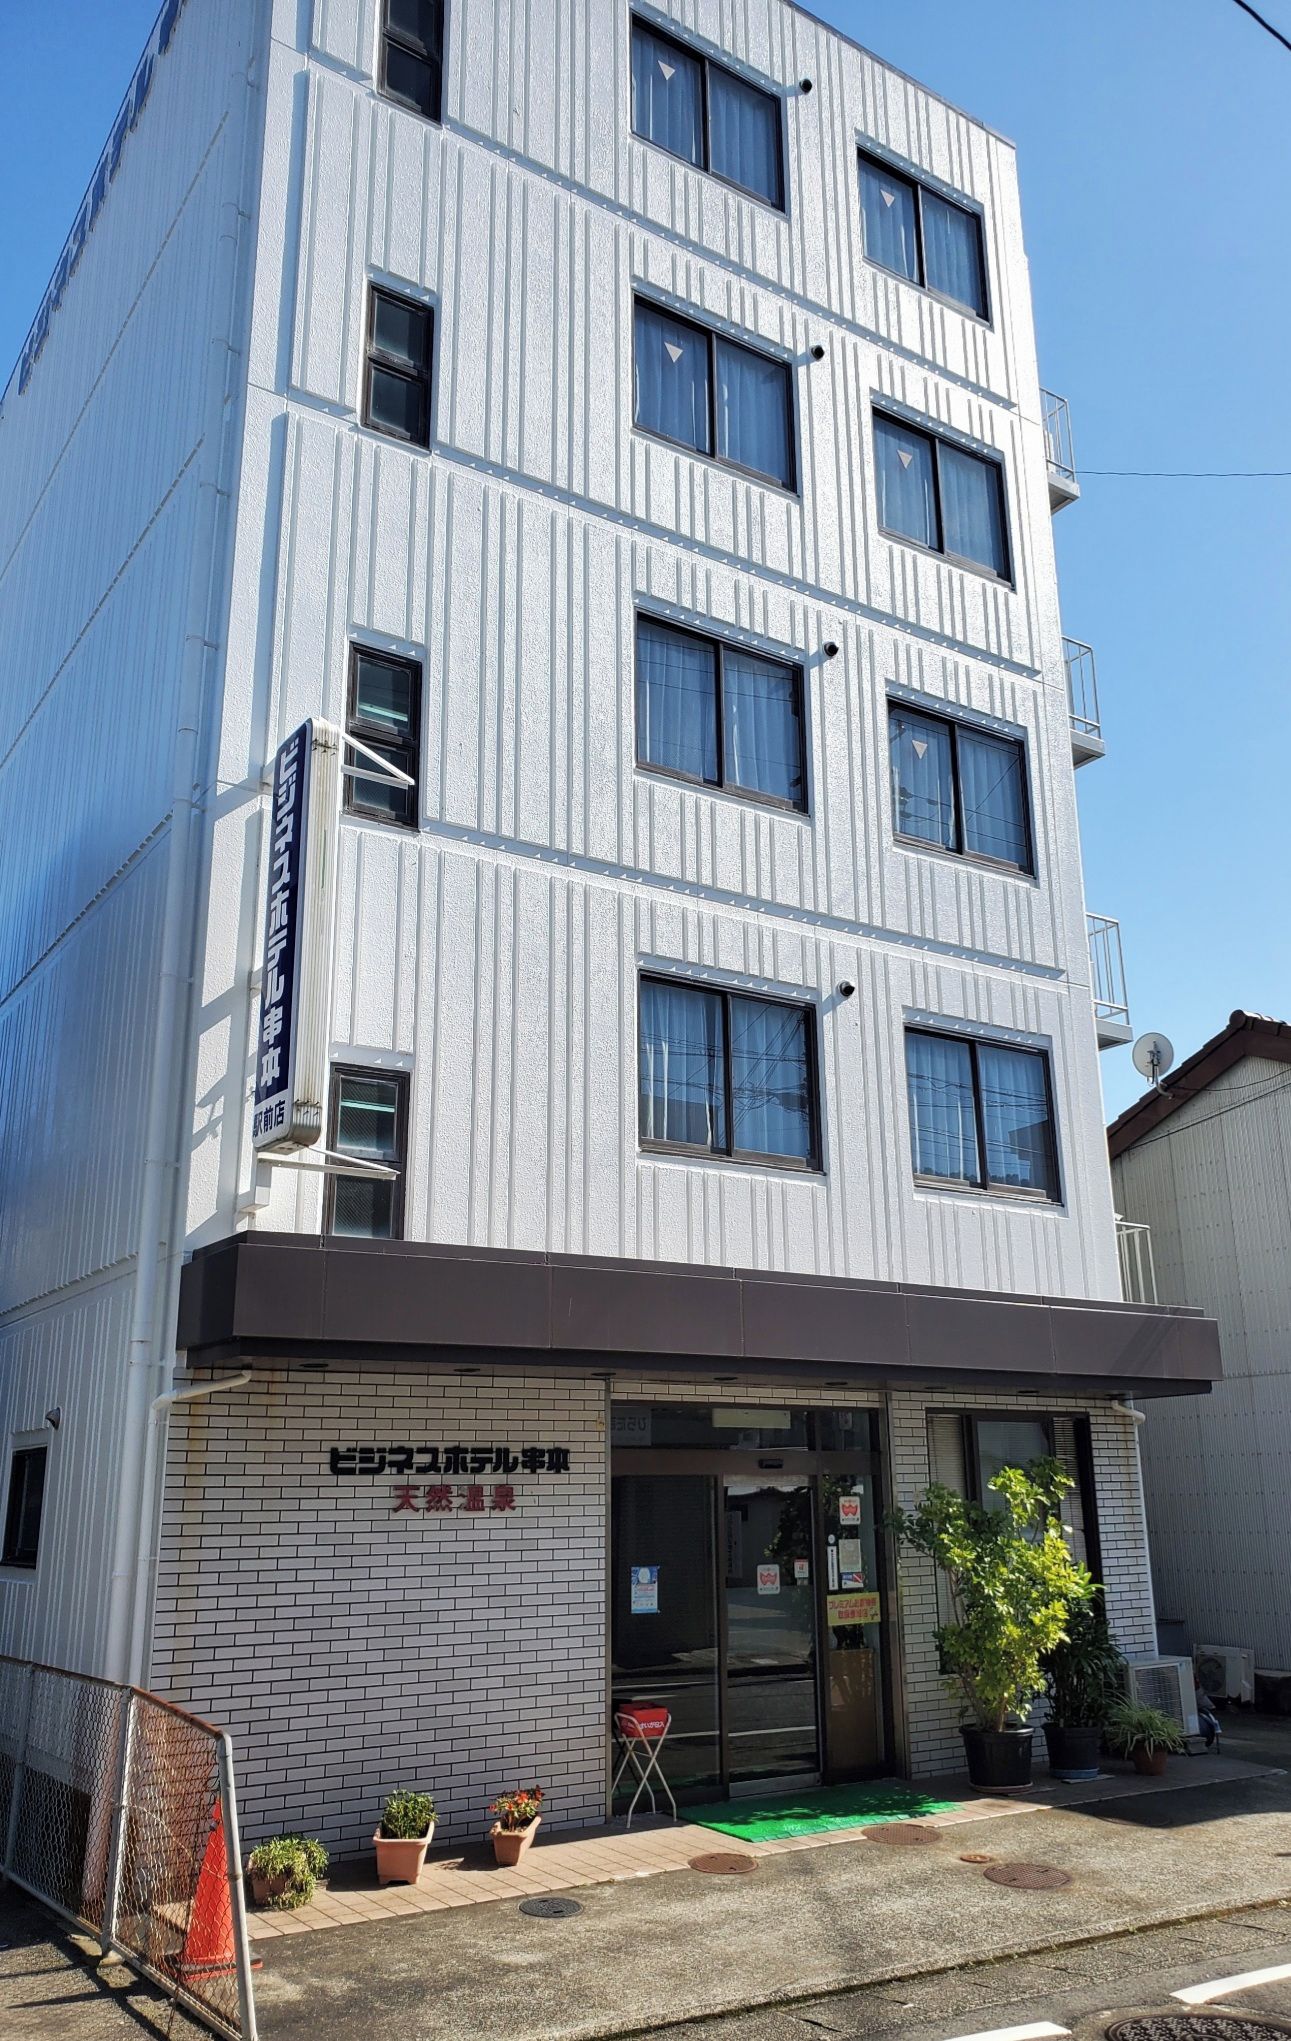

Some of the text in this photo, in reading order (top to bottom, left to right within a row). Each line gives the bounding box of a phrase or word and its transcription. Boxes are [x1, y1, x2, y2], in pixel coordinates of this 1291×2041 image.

[260, 737, 299, 1088] ビジネスホテル串本
[252, 1099, 286, 1138] 駅前店
[329, 1445, 571, 1476] ビジネスホテル串本
[392, 1484, 517, 1513] 天然温泉
